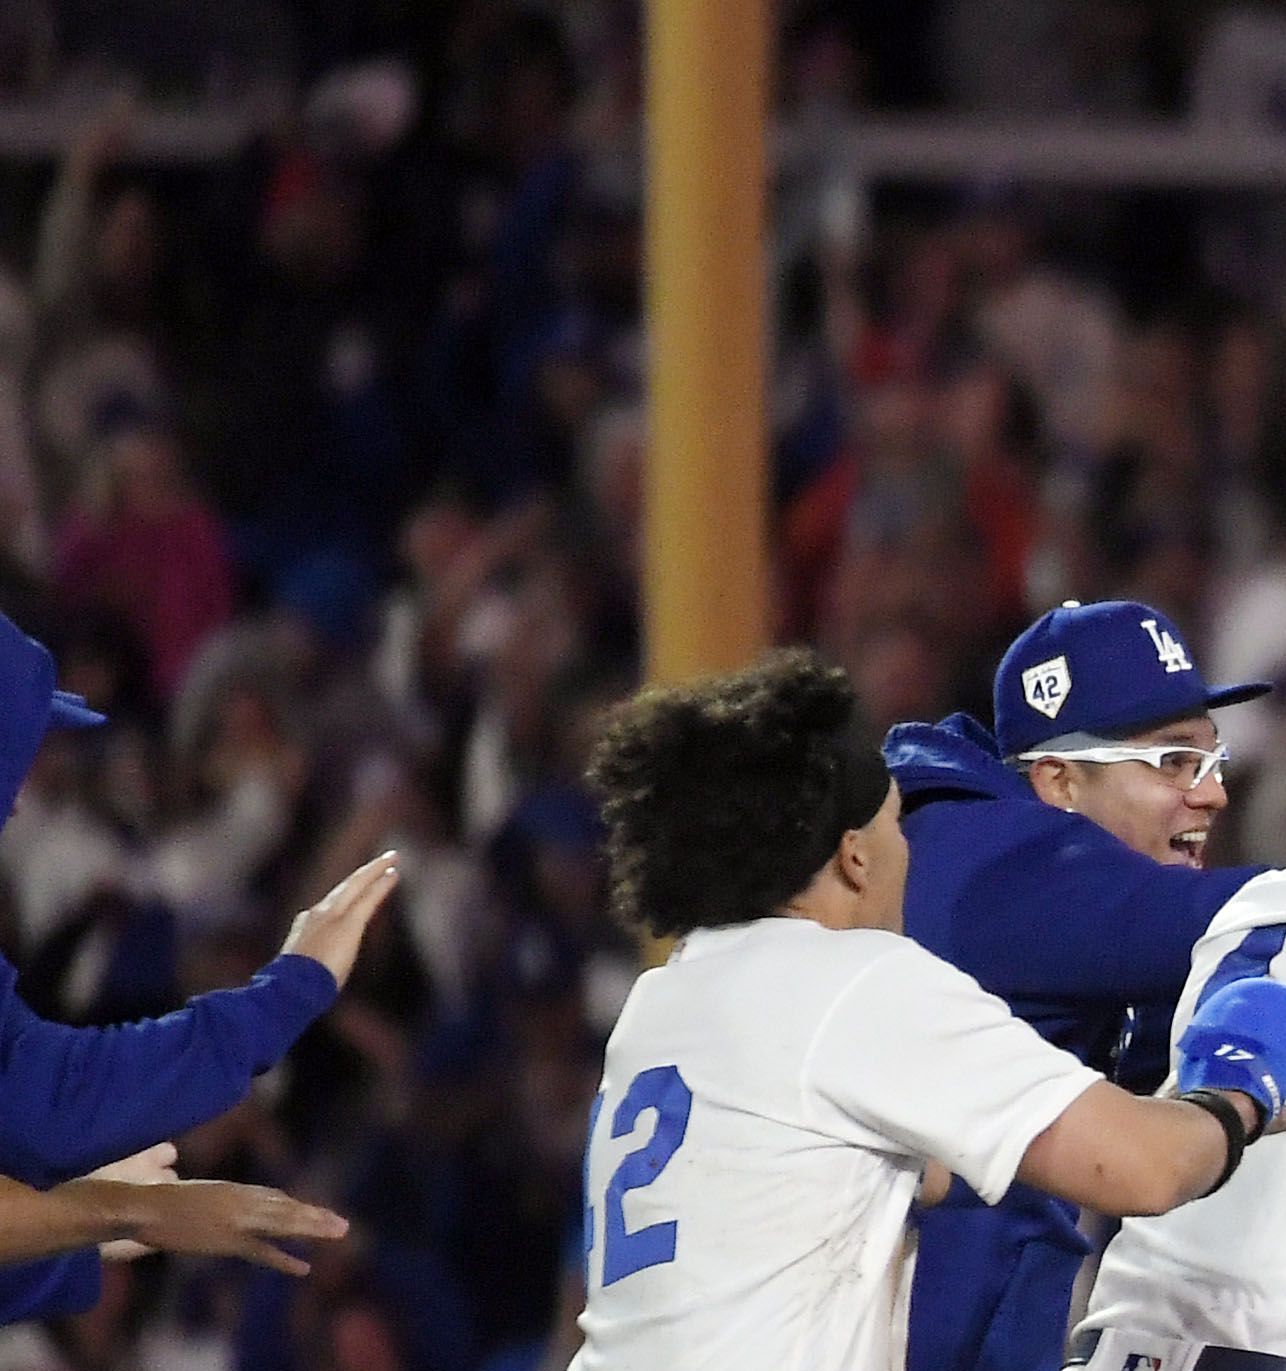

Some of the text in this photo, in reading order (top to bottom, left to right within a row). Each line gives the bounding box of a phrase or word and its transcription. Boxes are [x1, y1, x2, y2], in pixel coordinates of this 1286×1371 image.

[1140, 619, 1193, 673] LA
[1032, 675, 1061, 702] 42
[583, 1064, 693, 1288] 2
